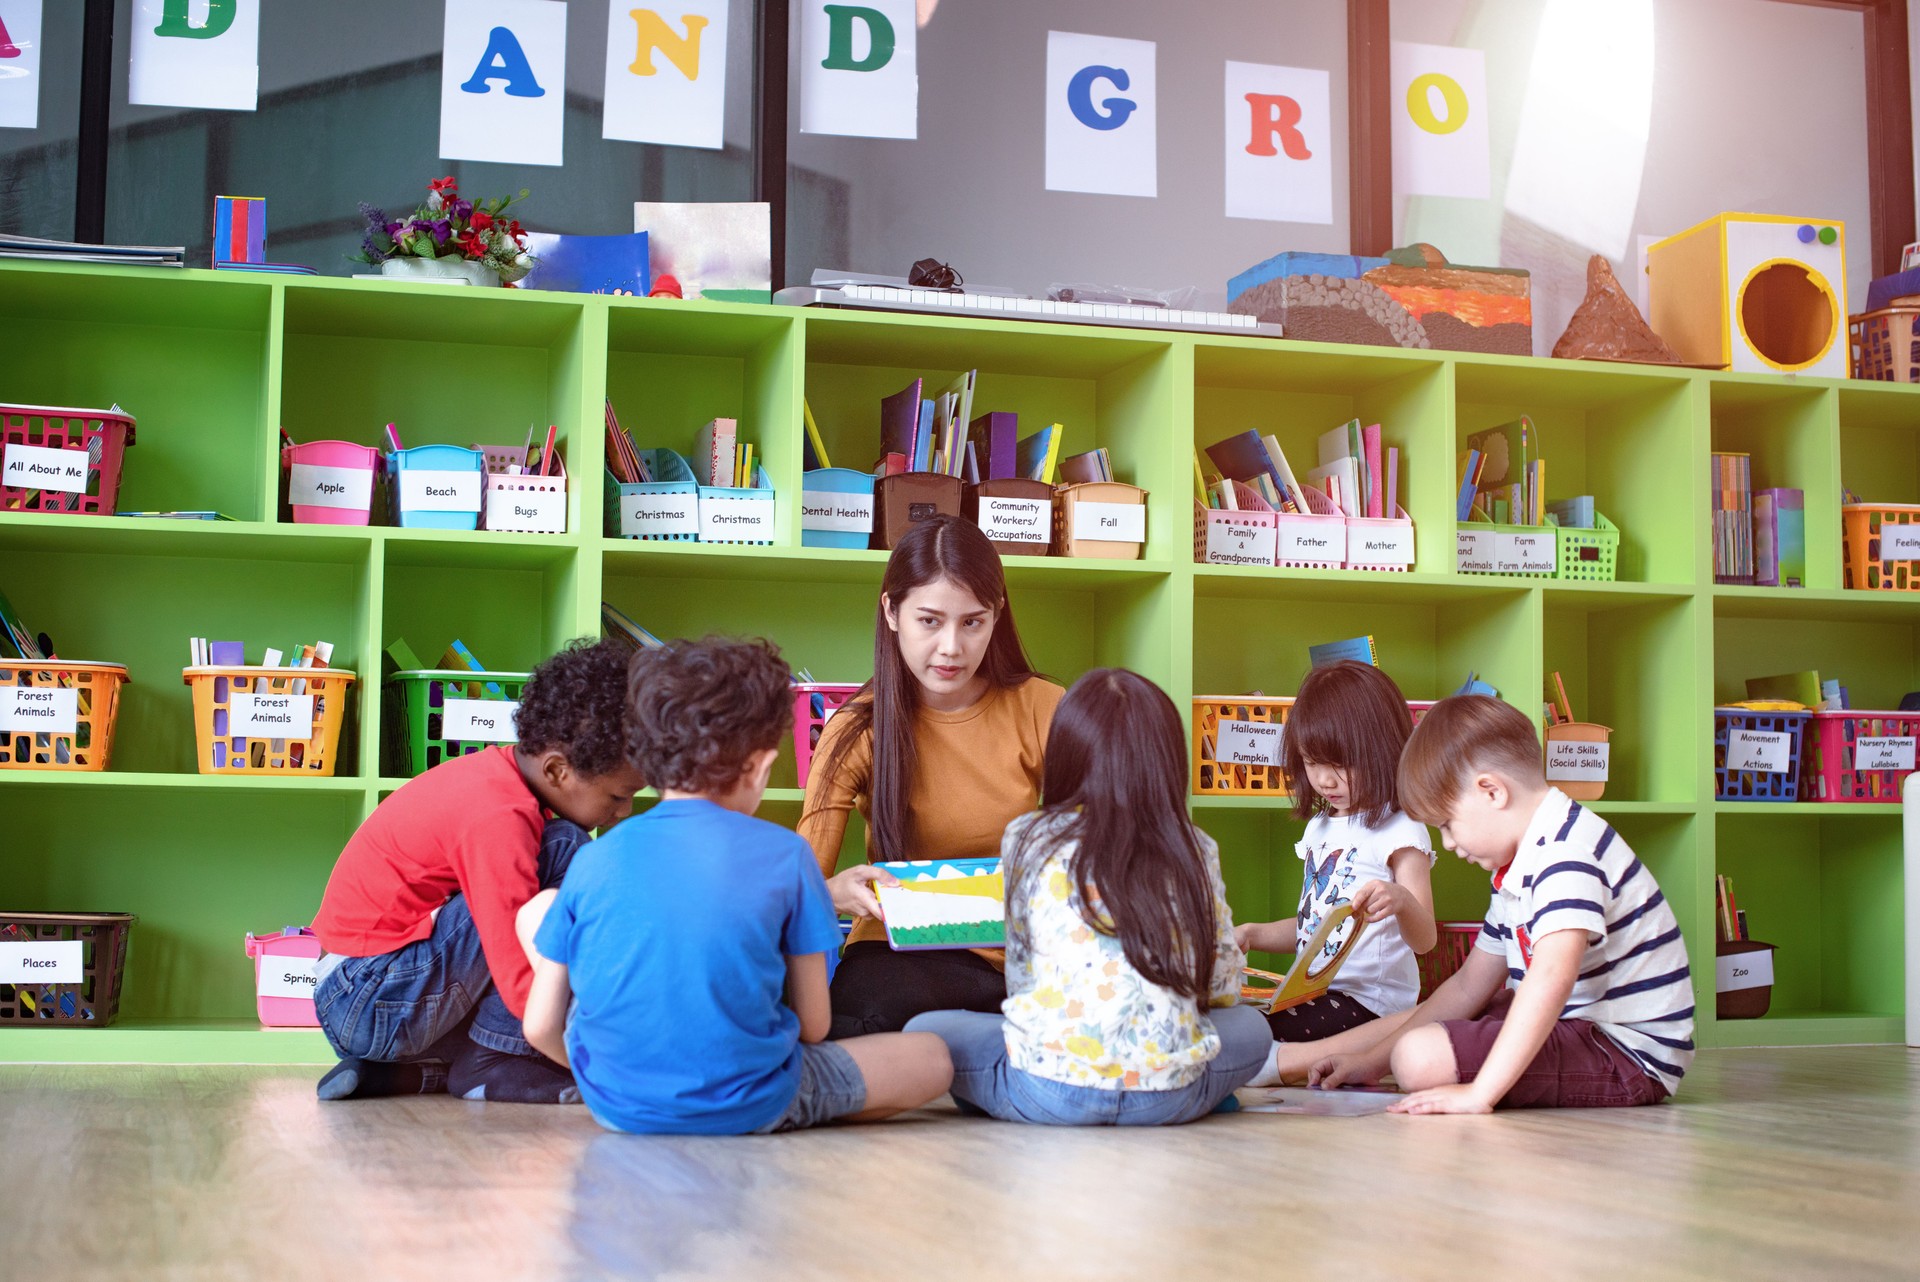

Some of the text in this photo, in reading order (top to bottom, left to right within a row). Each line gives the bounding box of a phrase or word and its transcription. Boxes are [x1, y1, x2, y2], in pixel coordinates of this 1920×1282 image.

[9, 462, 82, 477] All About Me
[316, 482, 345, 493] Apple
[426, 486, 456, 496] Beach
[515, 506, 538, 518] Bugs
[801, 505, 870, 519] Dental Health
[990, 501, 1040, 514] Community
[635, 510, 685, 520] Christmas
[712, 514, 761, 525] Christmas
[992, 515, 1038, 526] Workers/
[1100, 517, 1118, 527] Fall
[986, 529, 1042, 541] Occupations
[1227, 527, 1257, 540] Family
[1238, 541, 1245, 549] &
[1296, 537, 1328, 547] Father
[1365, 541, 1397, 550] Mother
[1514, 536, 1536, 546] Farm
[1896, 538, 1920, 549] Feelin
[1210, 551, 1271, 565] Grandparents
[1461, 561, 1493, 570] Animals
[1498, 561, 1553, 570] Farm Animals
[17, 690, 54, 701] Forest
[254, 697, 289, 708] Forest
[14, 707, 56, 717] Animals
[251, 713, 292, 723] Animals
[471, 716, 495, 729] Frog
[1231, 724, 1277, 736] Halloween
[1249, 739, 1256, 748] &
[1740, 733, 1780, 744] Movement
[1859, 738, 1913, 748] Nursery Rhymes
[1557, 745, 1599, 754] Life Skills
[1879, 750, 1893, 758] And
[1233, 751, 1269, 764] Pumpkin
[1549, 758, 1606, 769] (Social Skills)
[1743, 760, 1773, 769] Actions
[1871, 760, 1900, 769] Lullabies
[23, 958, 57, 968] Places
[1732, 968, 1749, 977] Zoo
[283, 973, 317, 986] Spring
